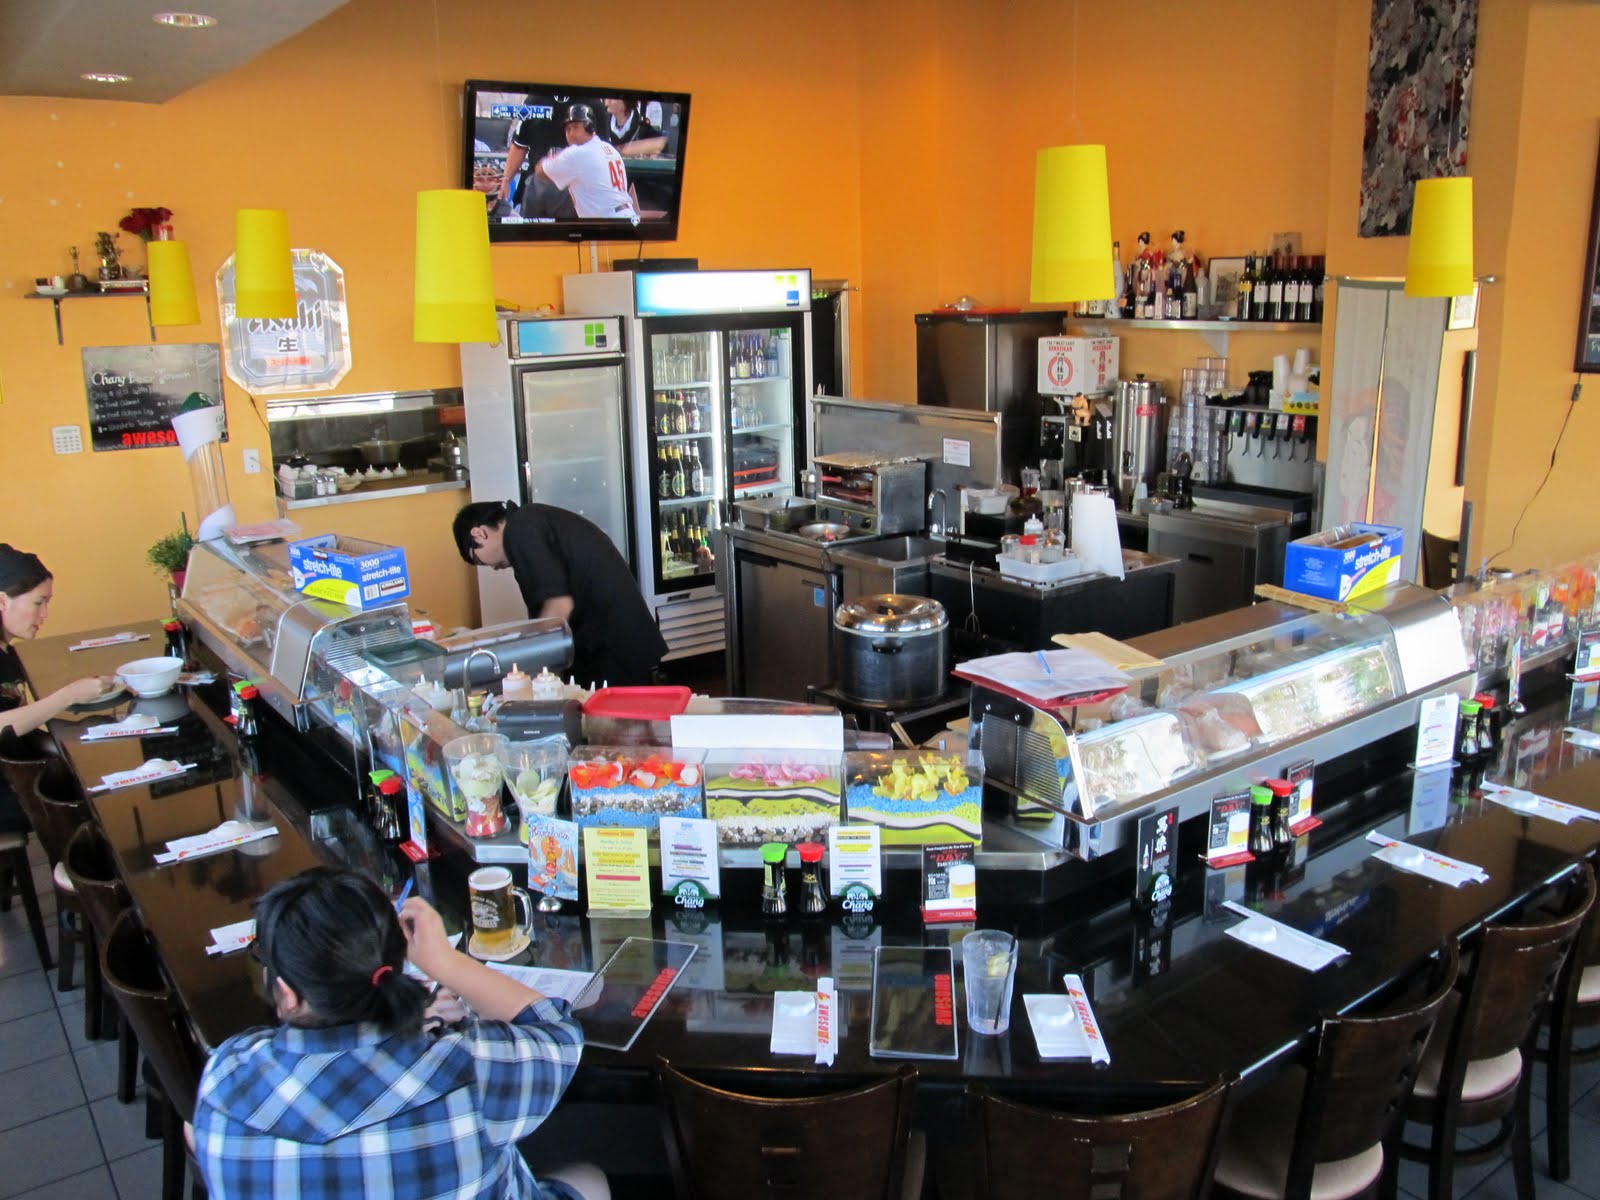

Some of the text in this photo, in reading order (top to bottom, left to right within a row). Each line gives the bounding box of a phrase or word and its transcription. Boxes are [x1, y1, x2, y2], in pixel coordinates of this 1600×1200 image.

[608, 160, 626, 192] 45
[278, 338, 298, 352] 生
[92, 371, 125, 387] Chang
[122, 430, 176, 446] aweso
[361, 557, 380, 569] 3000
[1355, 545, 1391, 570] stretch-tite
[303, 558, 342, 579] stretch-tite
[362, 566, 401, 582] stretch-tite
[675, 895, 704, 908] Chang
[842, 900, 873, 911] Chang
[818, 1004, 829, 1044] awesome
[1075, 1001, 1098, 1040] awesome
